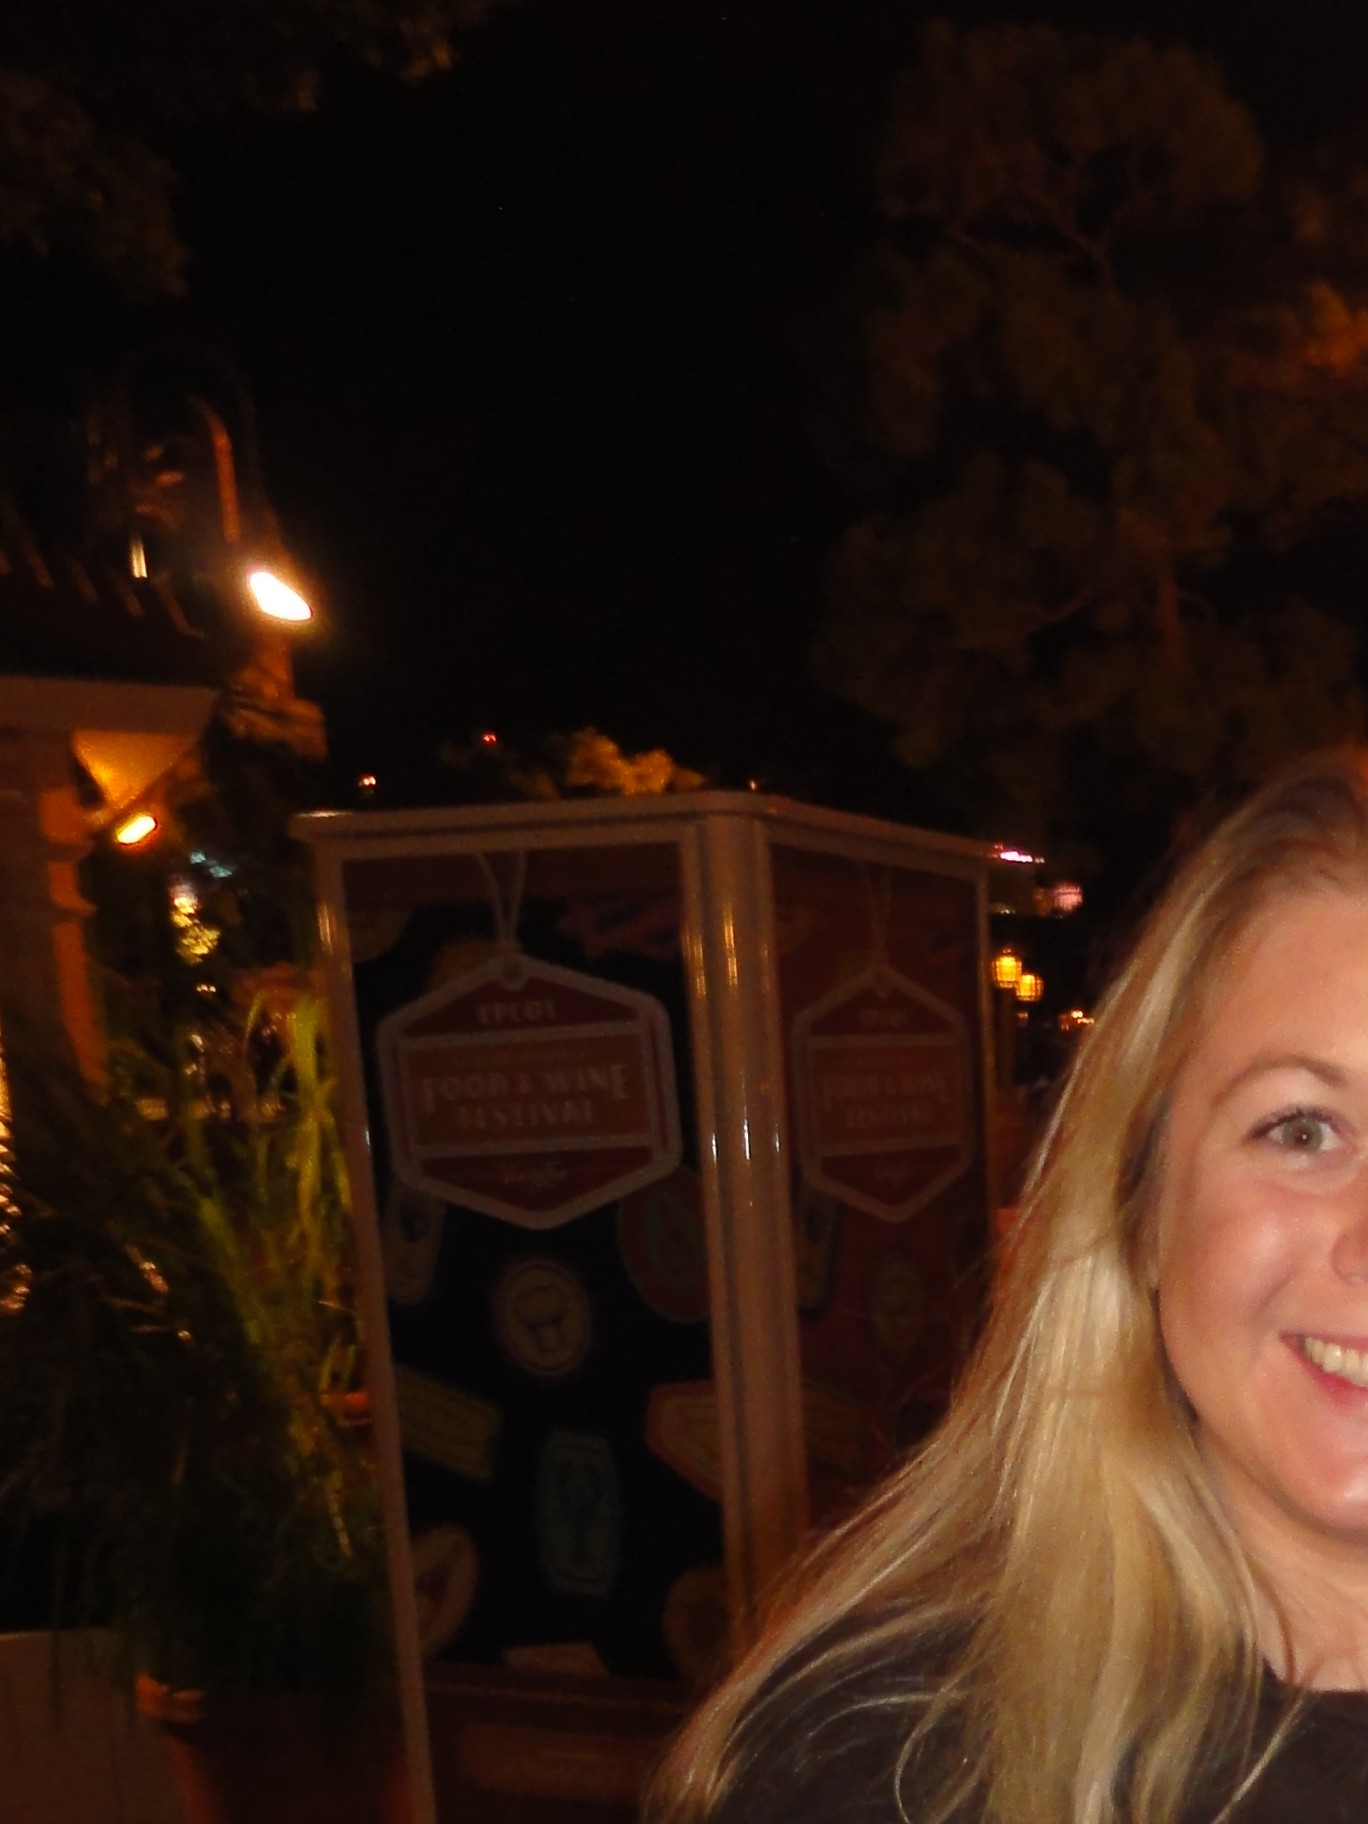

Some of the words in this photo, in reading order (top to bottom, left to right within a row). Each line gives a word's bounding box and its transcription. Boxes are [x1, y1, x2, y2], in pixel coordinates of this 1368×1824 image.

[421, 1071, 510, 1114] FOOD
[542, 1063, 631, 1101] WINE
[456, 1099, 594, 1131] FESTIVAL
